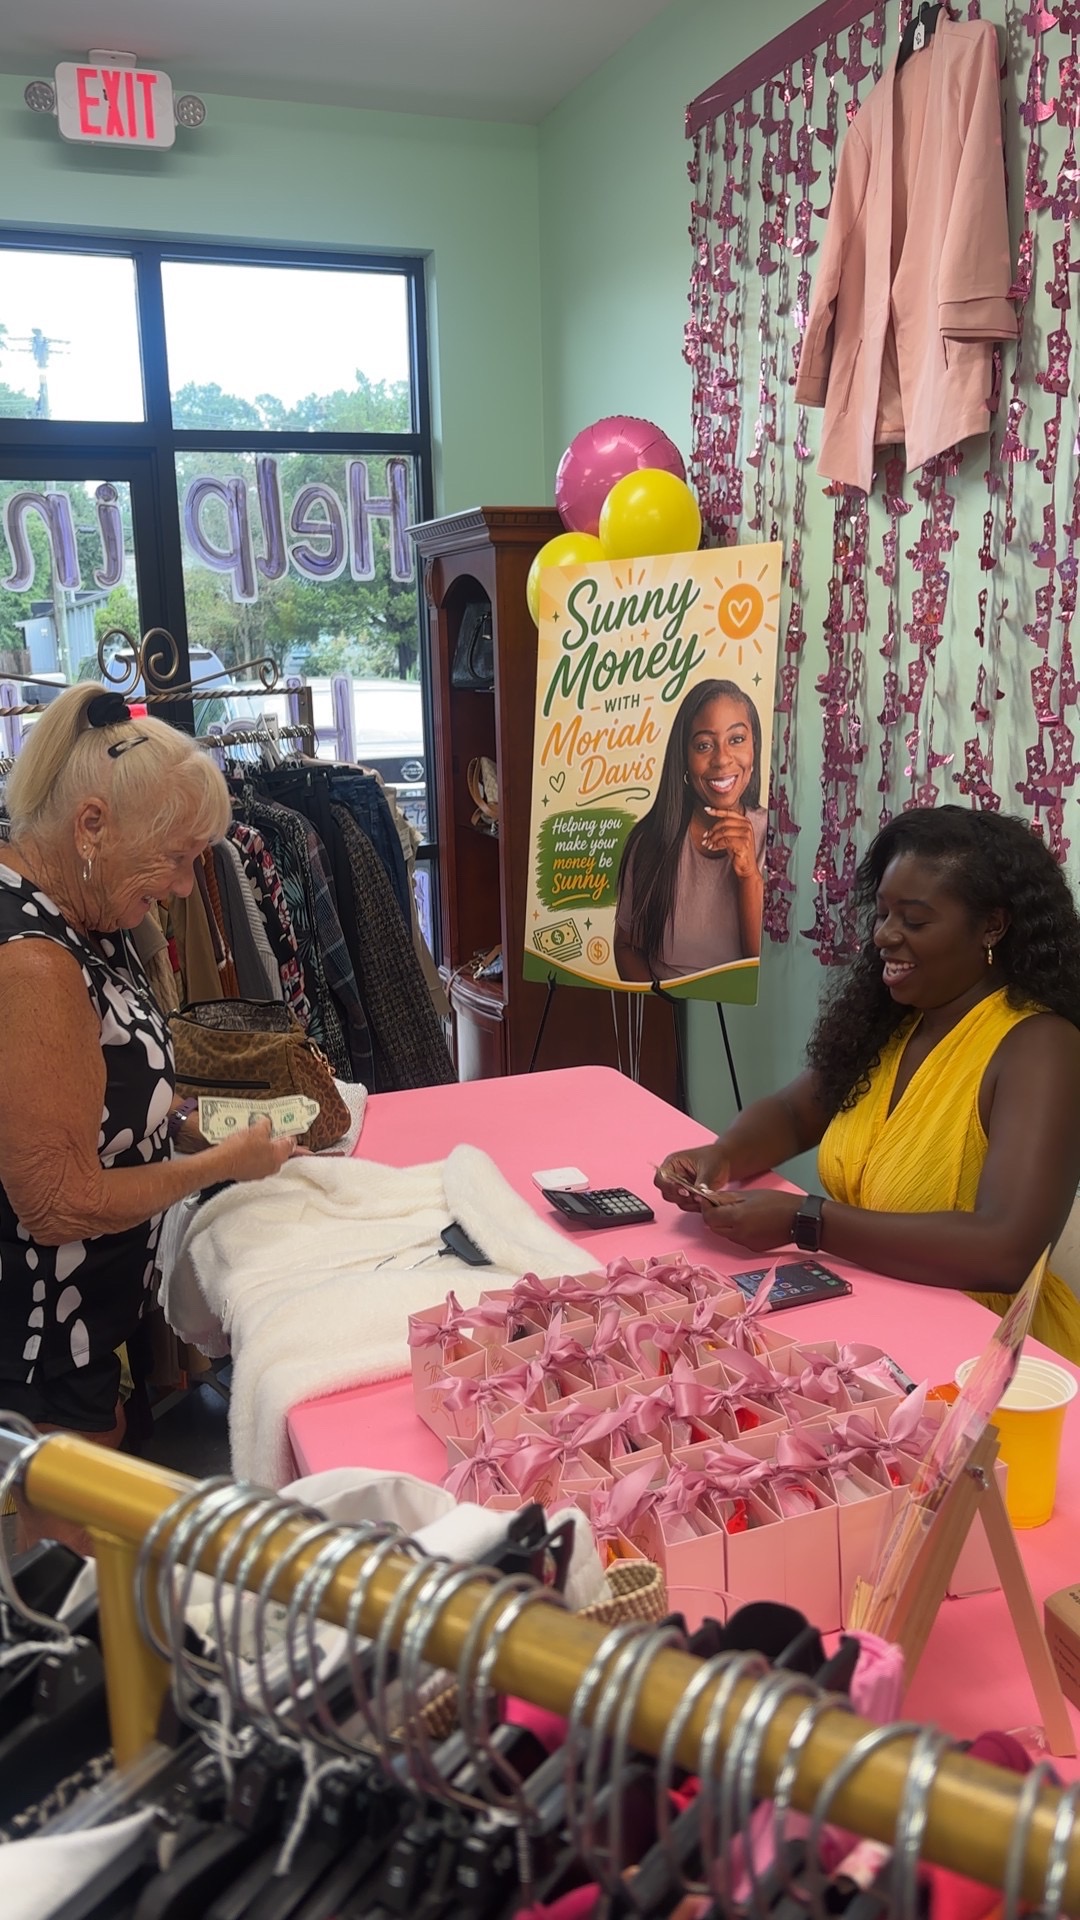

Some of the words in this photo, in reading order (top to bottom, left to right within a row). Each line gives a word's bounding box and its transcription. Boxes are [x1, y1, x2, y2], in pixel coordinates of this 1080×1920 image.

[76, 67, 157, 139] EXIT
[562, 579, 701, 650] Sunny
[543, 634, 706, 717] Money
[604, 694, 640, 713] WITH
[541, 706, 661, 766] Moriah
[578, 753, 656, 794] Davis
[552, 816, 597, 838] Helping
[598, 818, 622, 836] you
[553, 857, 596, 874] money
[599, 852, 613, 868] be
[555, 835, 587, 852] make
[589, 838, 618, 857] your
[551, 873, 610, 900] Sunny.
